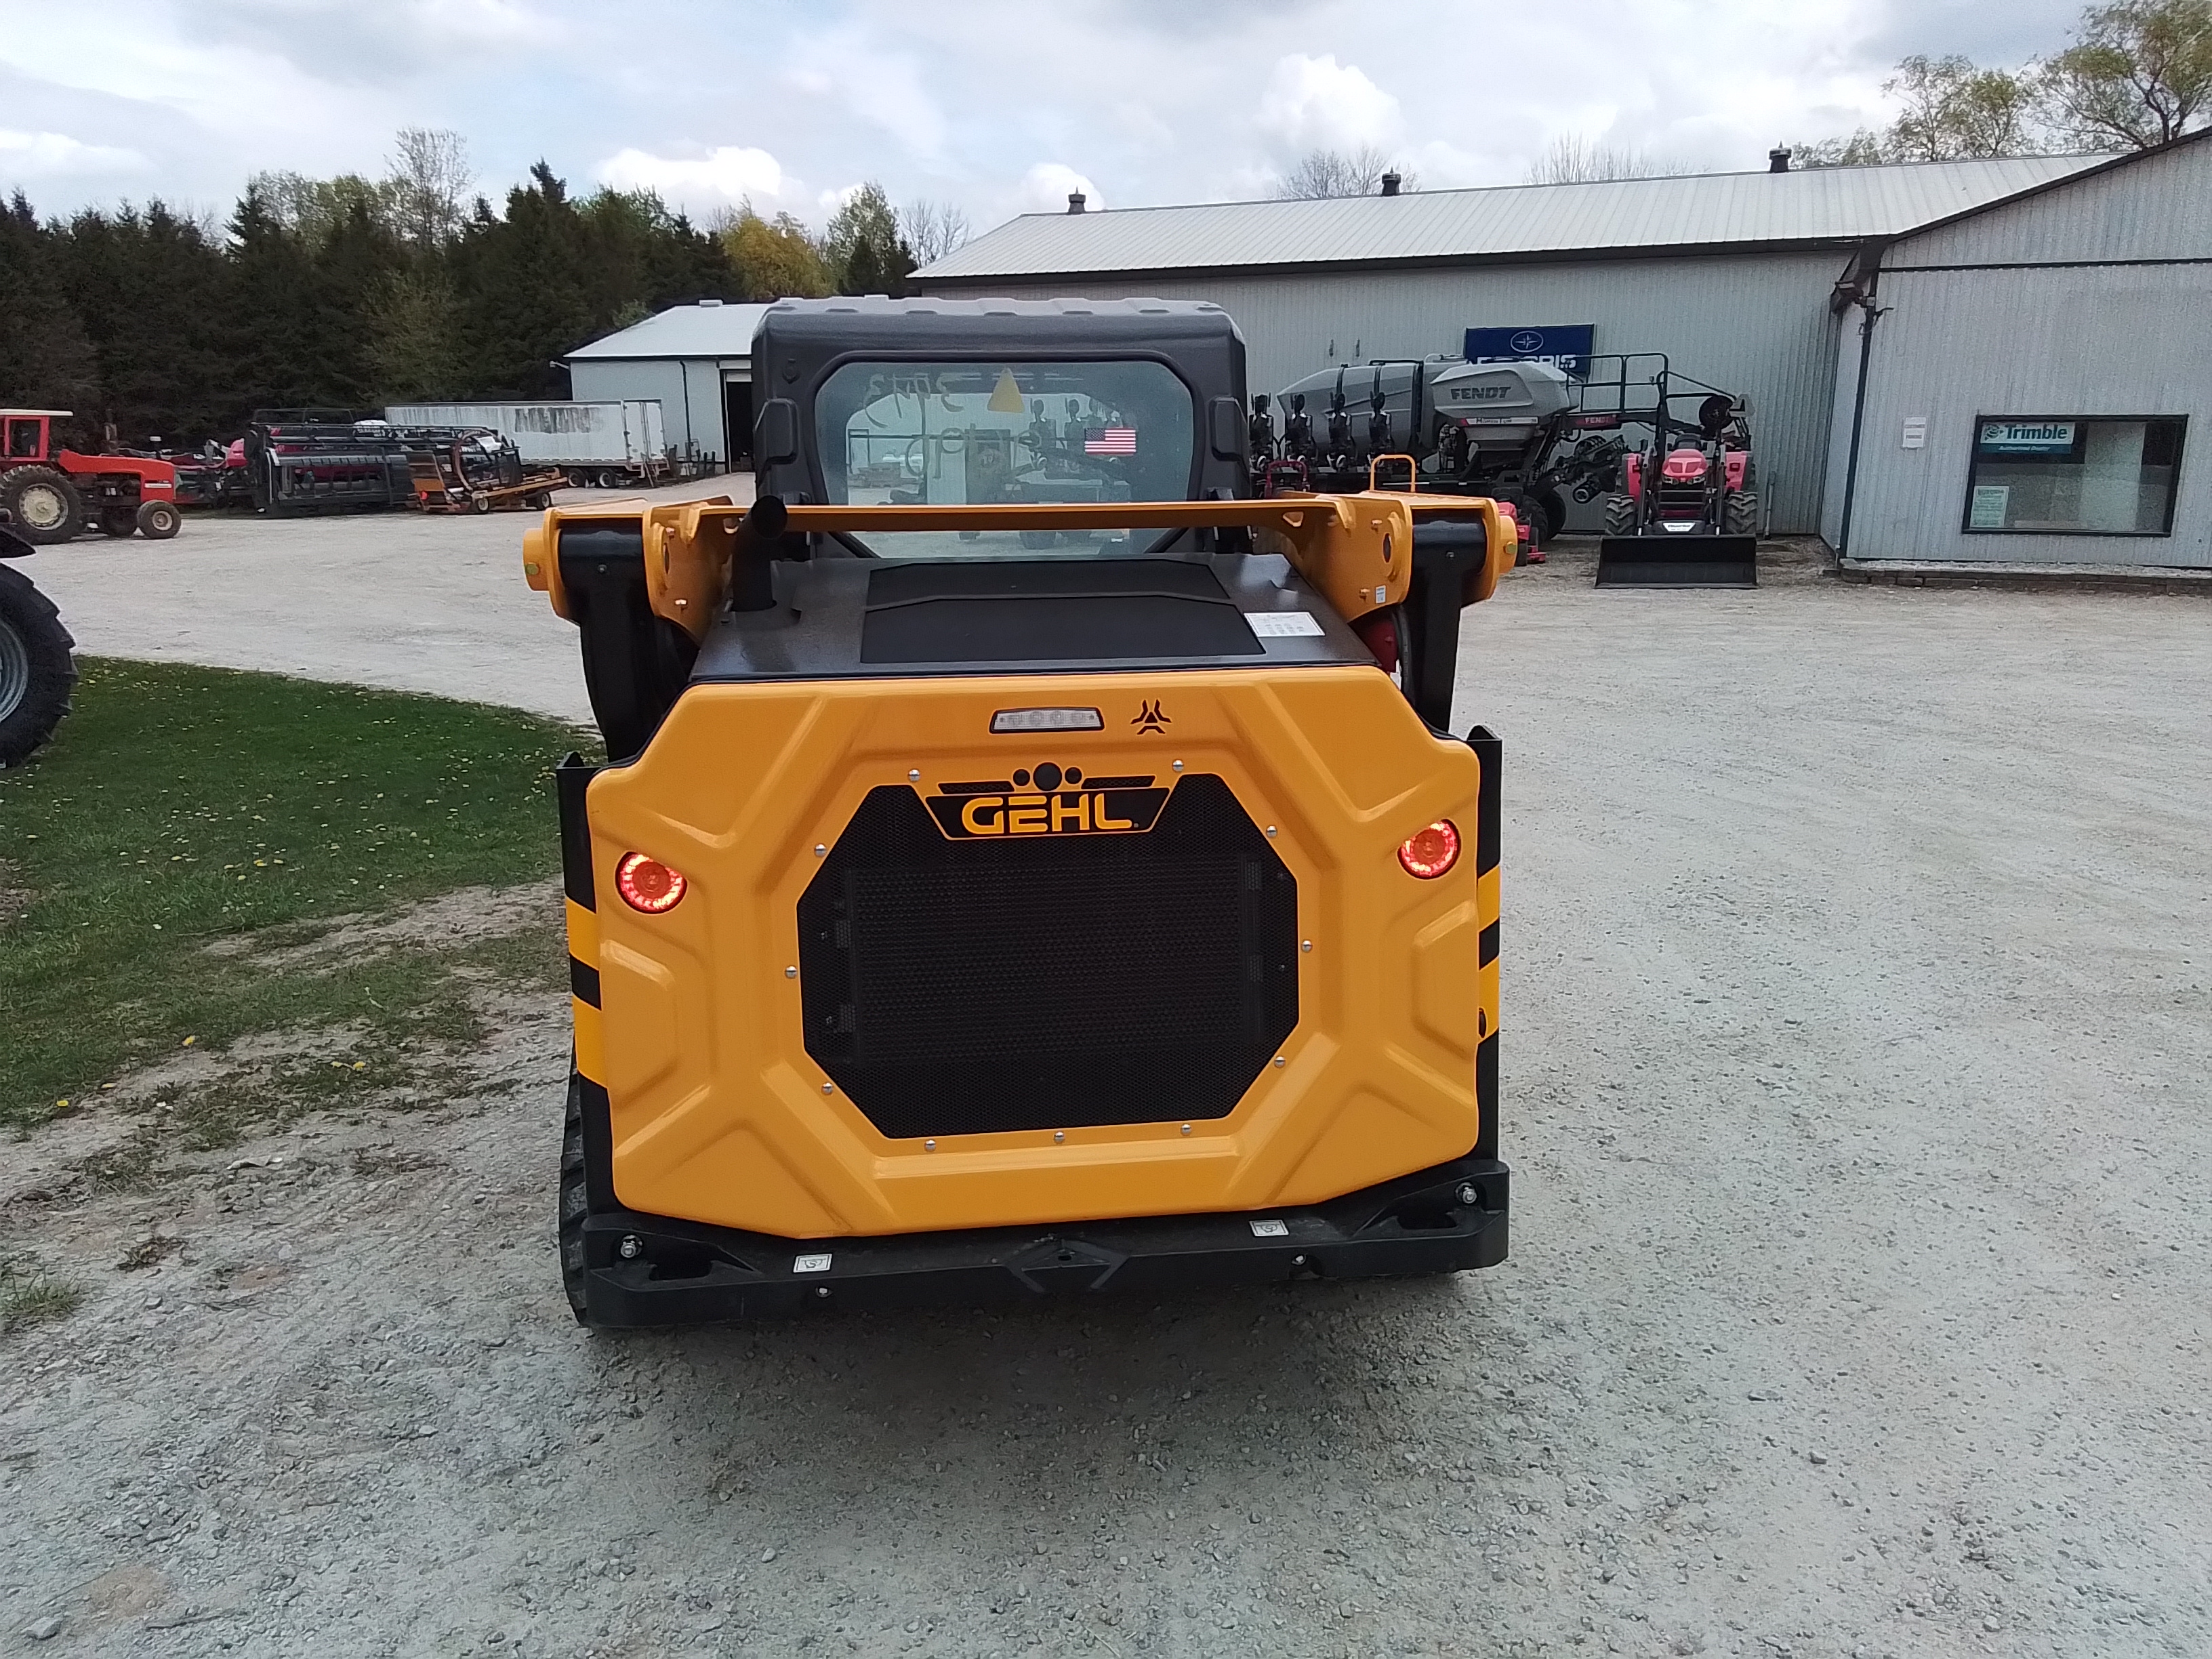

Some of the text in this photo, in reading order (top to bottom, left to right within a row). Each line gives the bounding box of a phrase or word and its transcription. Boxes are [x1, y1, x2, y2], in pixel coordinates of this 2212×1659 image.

[1450, 386, 1511, 400] FENDT
[2004, 424, 2068, 440] Trimble
[962, 792, 1133, 834] GEHL
